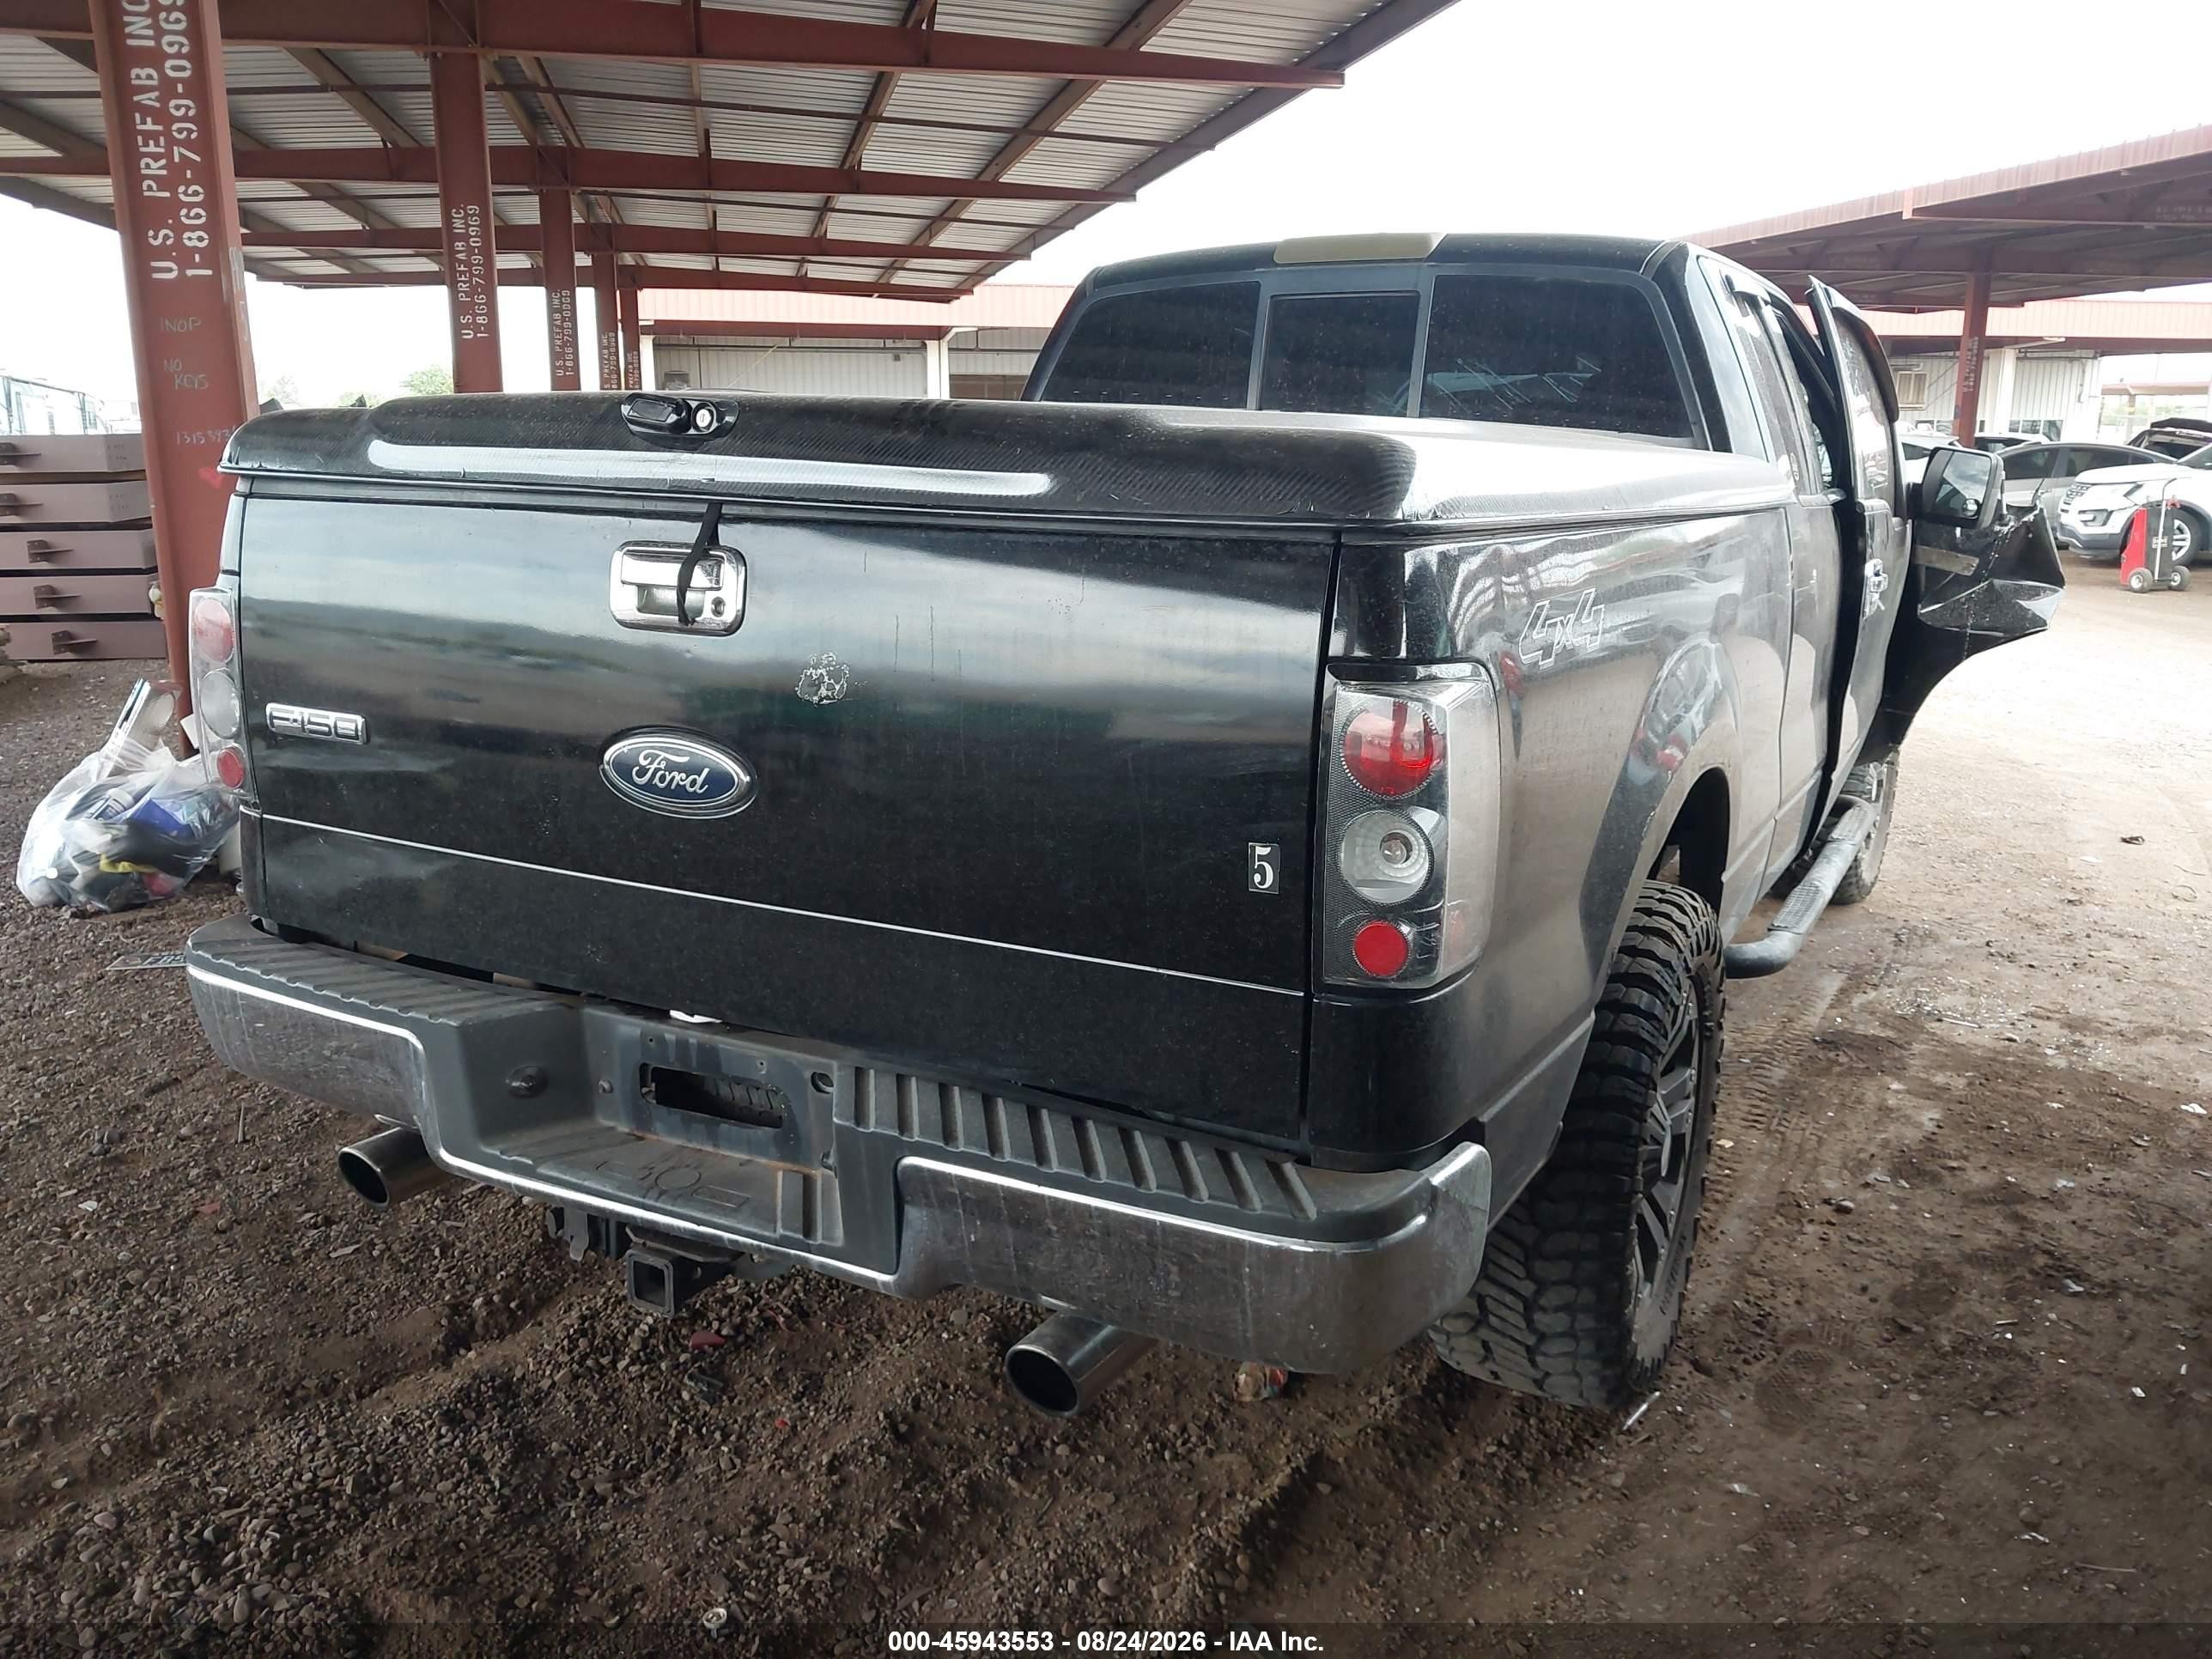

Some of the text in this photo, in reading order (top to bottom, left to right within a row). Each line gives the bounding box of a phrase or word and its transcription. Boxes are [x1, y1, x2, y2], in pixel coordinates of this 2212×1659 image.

[131, 67, 171, 198] PREFAB
[148, 219, 179, 279] U.S.
[452, 204, 474, 339] U.S. PREFAB INC.
[466, 204, 489, 337] 1-866-799-0969
[160, 316, 202, 332] INOP
[552, 313, 563, 352] PREFAB
[163, 358, 182, 373] NO
[1518, 588, 1605, 669] 4x4
[631, 749, 710, 794] Ford
[1251, 845, 1274, 890] 5
